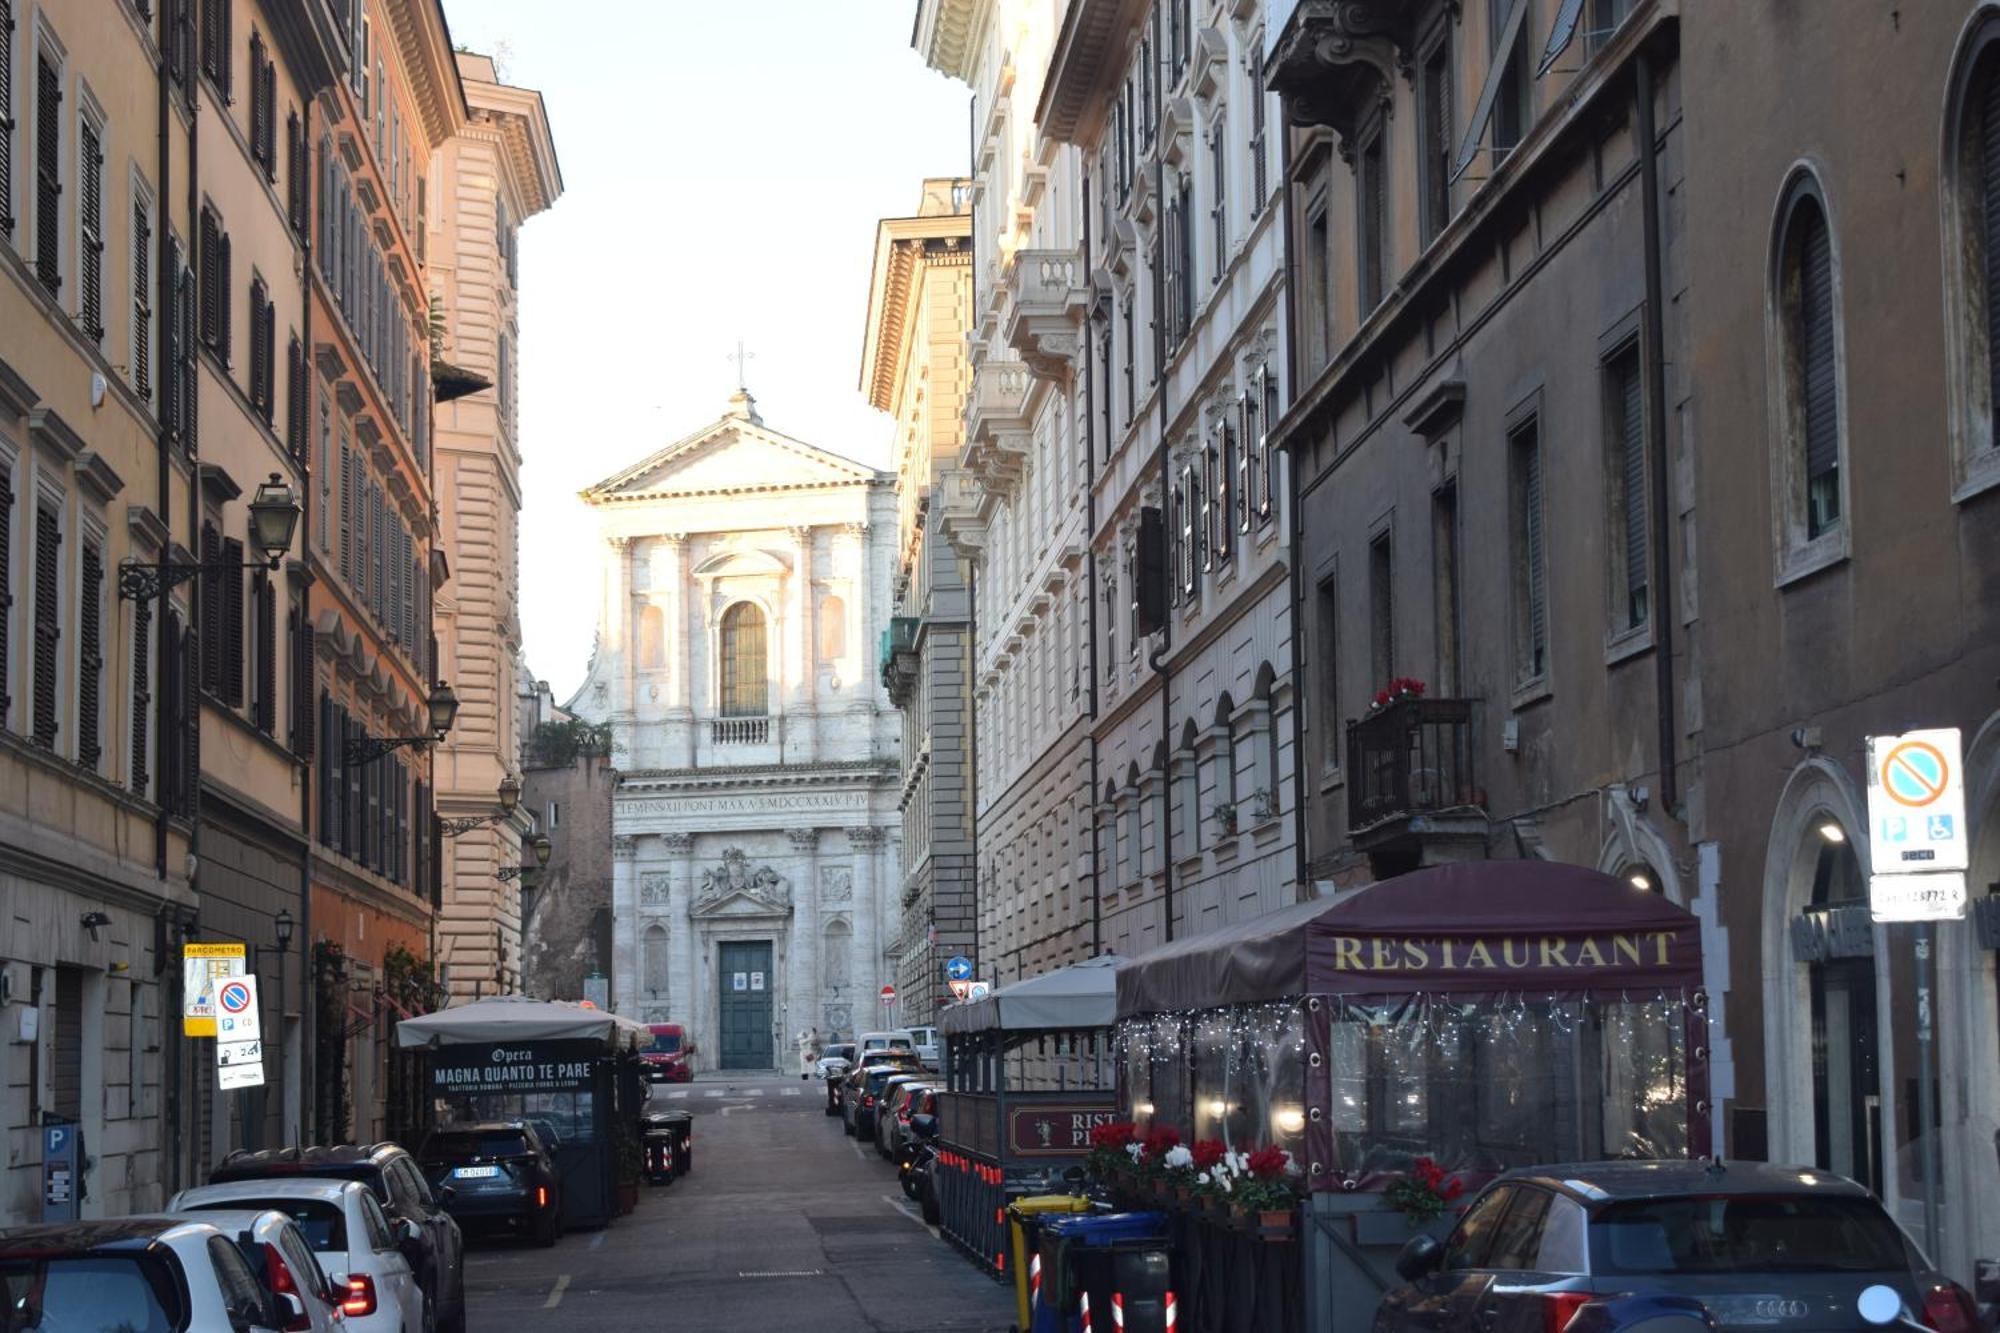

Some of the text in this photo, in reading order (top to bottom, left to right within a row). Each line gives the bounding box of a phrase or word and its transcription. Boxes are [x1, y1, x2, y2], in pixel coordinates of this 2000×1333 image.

[187, 946, 242, 954] PARCOMETRO
[1333, 931, 1676, 971] RESTAURANT
[491, 1048, 532, 1063] Opera
[435, 1063, 590, 1084] MAGNA QUANTO TE PARE
[51, 1129, 64, 1149] P
